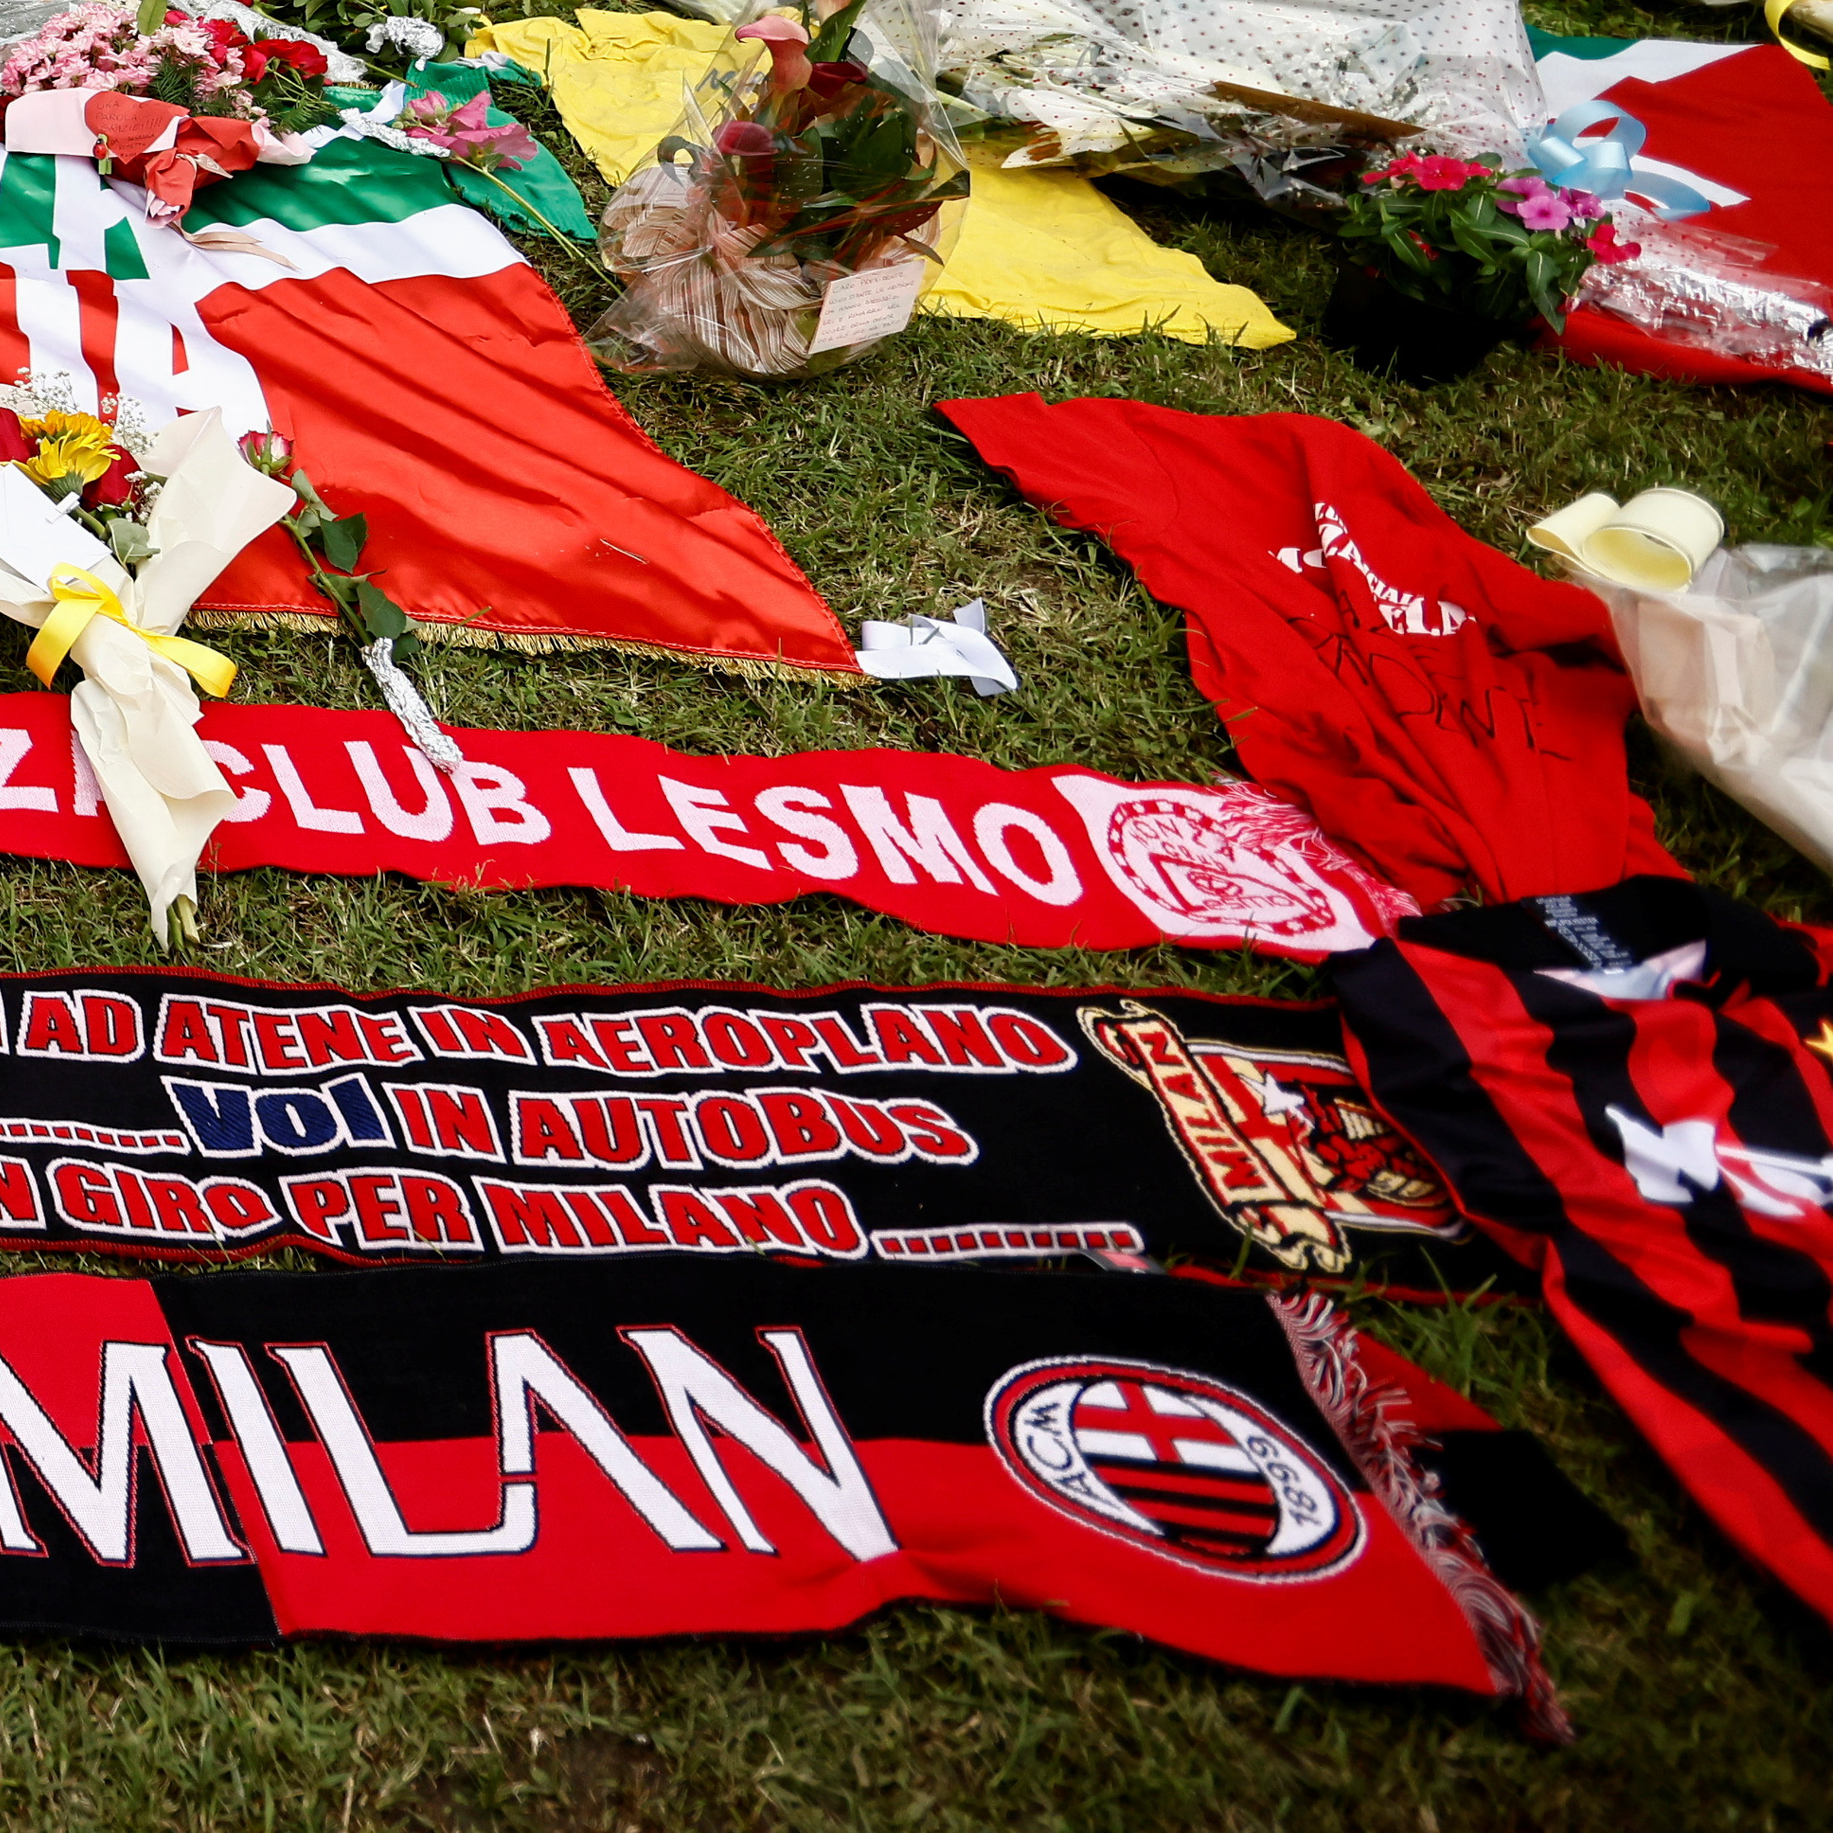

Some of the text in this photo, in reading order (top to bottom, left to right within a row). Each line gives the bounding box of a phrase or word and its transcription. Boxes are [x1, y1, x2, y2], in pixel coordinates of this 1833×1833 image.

[217, 734, 552, 846] CLUB
[564, 766, 1085, 907] LESMO
[17, 987, 144, 1066] AD
[153, 991, 416, 1076] ATENE
[420, 1001, 532, 1068] IN
[537, 998, 1076, 1080] AEROPLANO
[385, 1083, 483, 1162] IN
[512, 1085, 981, 1172] AUTOBUS
[1137, 1030, 1268, 1190] MILAN
[55, 1157, 282, 1242] GIRO
[283, 1166, 487, 1253] PER
[1016, 1396, 1097, 1526] ACM
[1242, 1432, 1325, 1530] 1899
